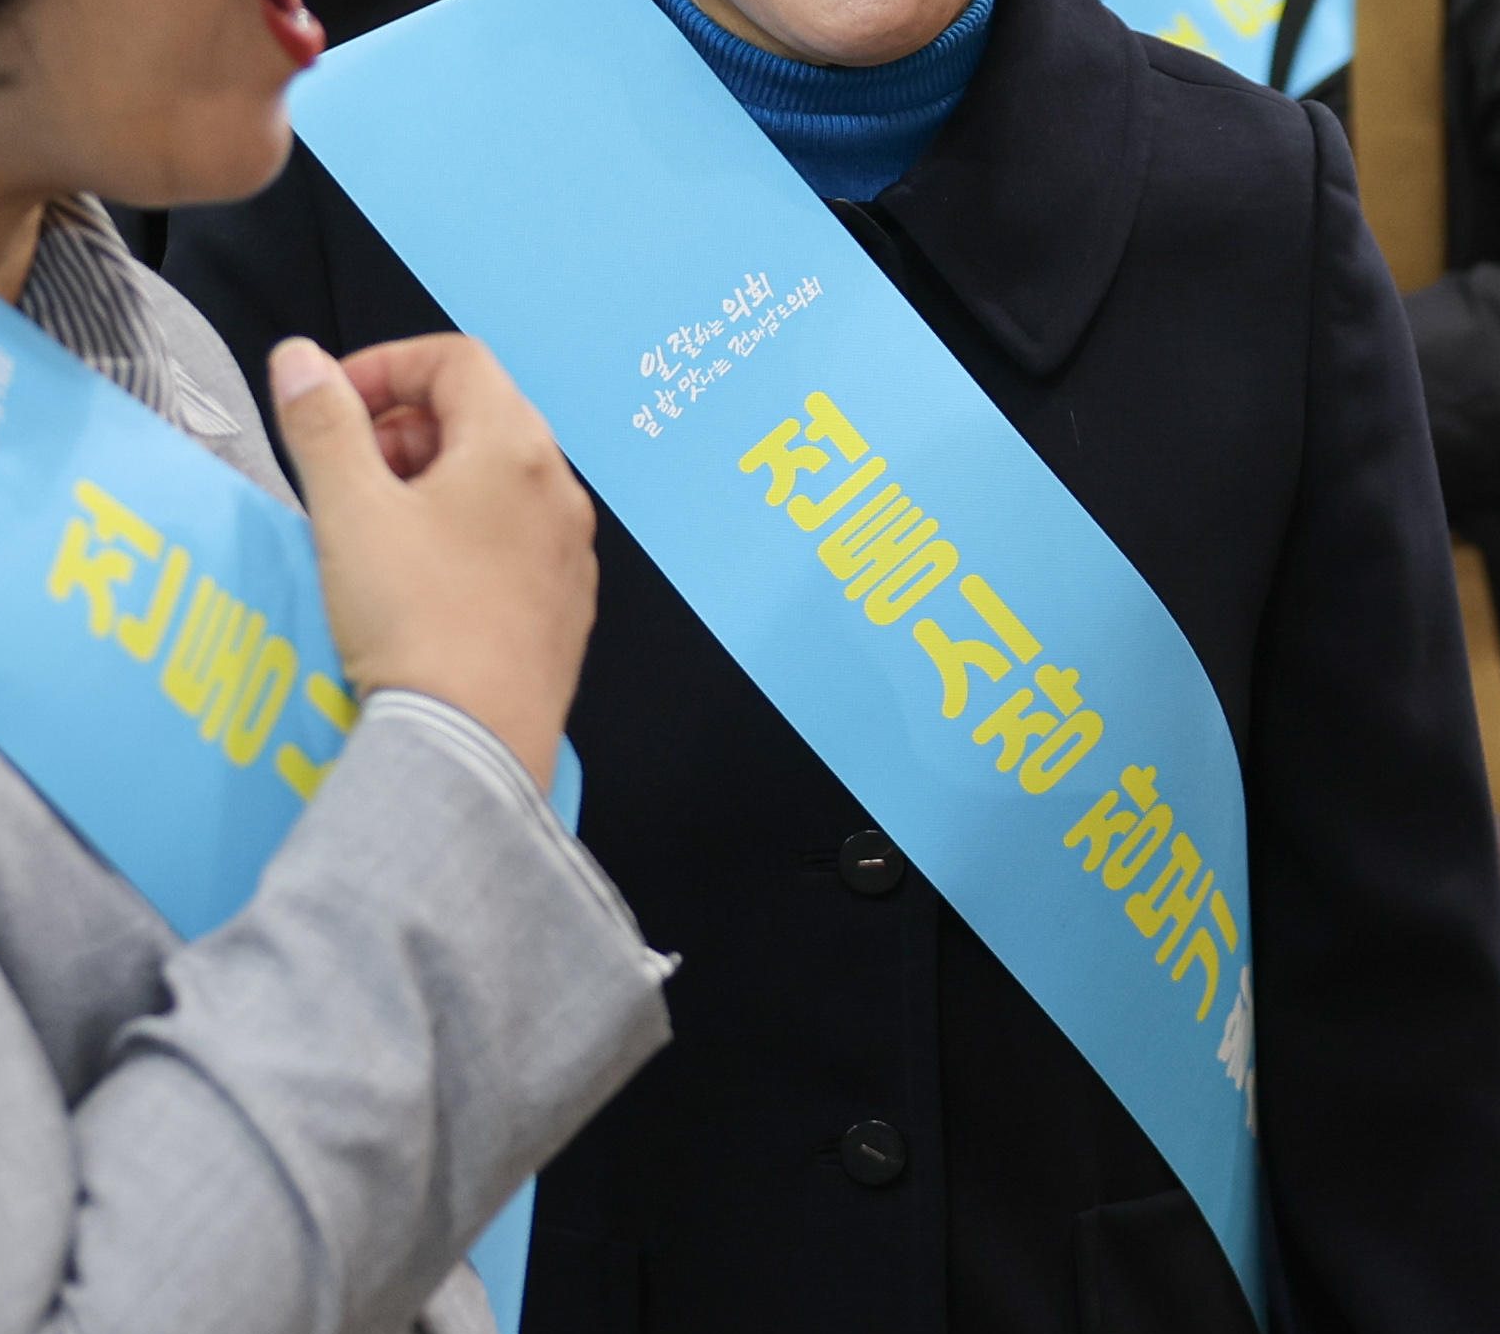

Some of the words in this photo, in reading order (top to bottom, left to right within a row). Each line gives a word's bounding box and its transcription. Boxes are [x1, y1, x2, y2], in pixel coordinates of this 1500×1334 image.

[639, 344, 683, 383] 일
[666, 319, 724, 359] 잘하는
[721, 271, 775, 323] 의회
[677, 357, 733, 403] 맛나는
[726, 275, 824, 358] 전라남도의회
[738, 391, 1104, 795] 전통시장
[1062, 764, 1240, 1022] 장보기
